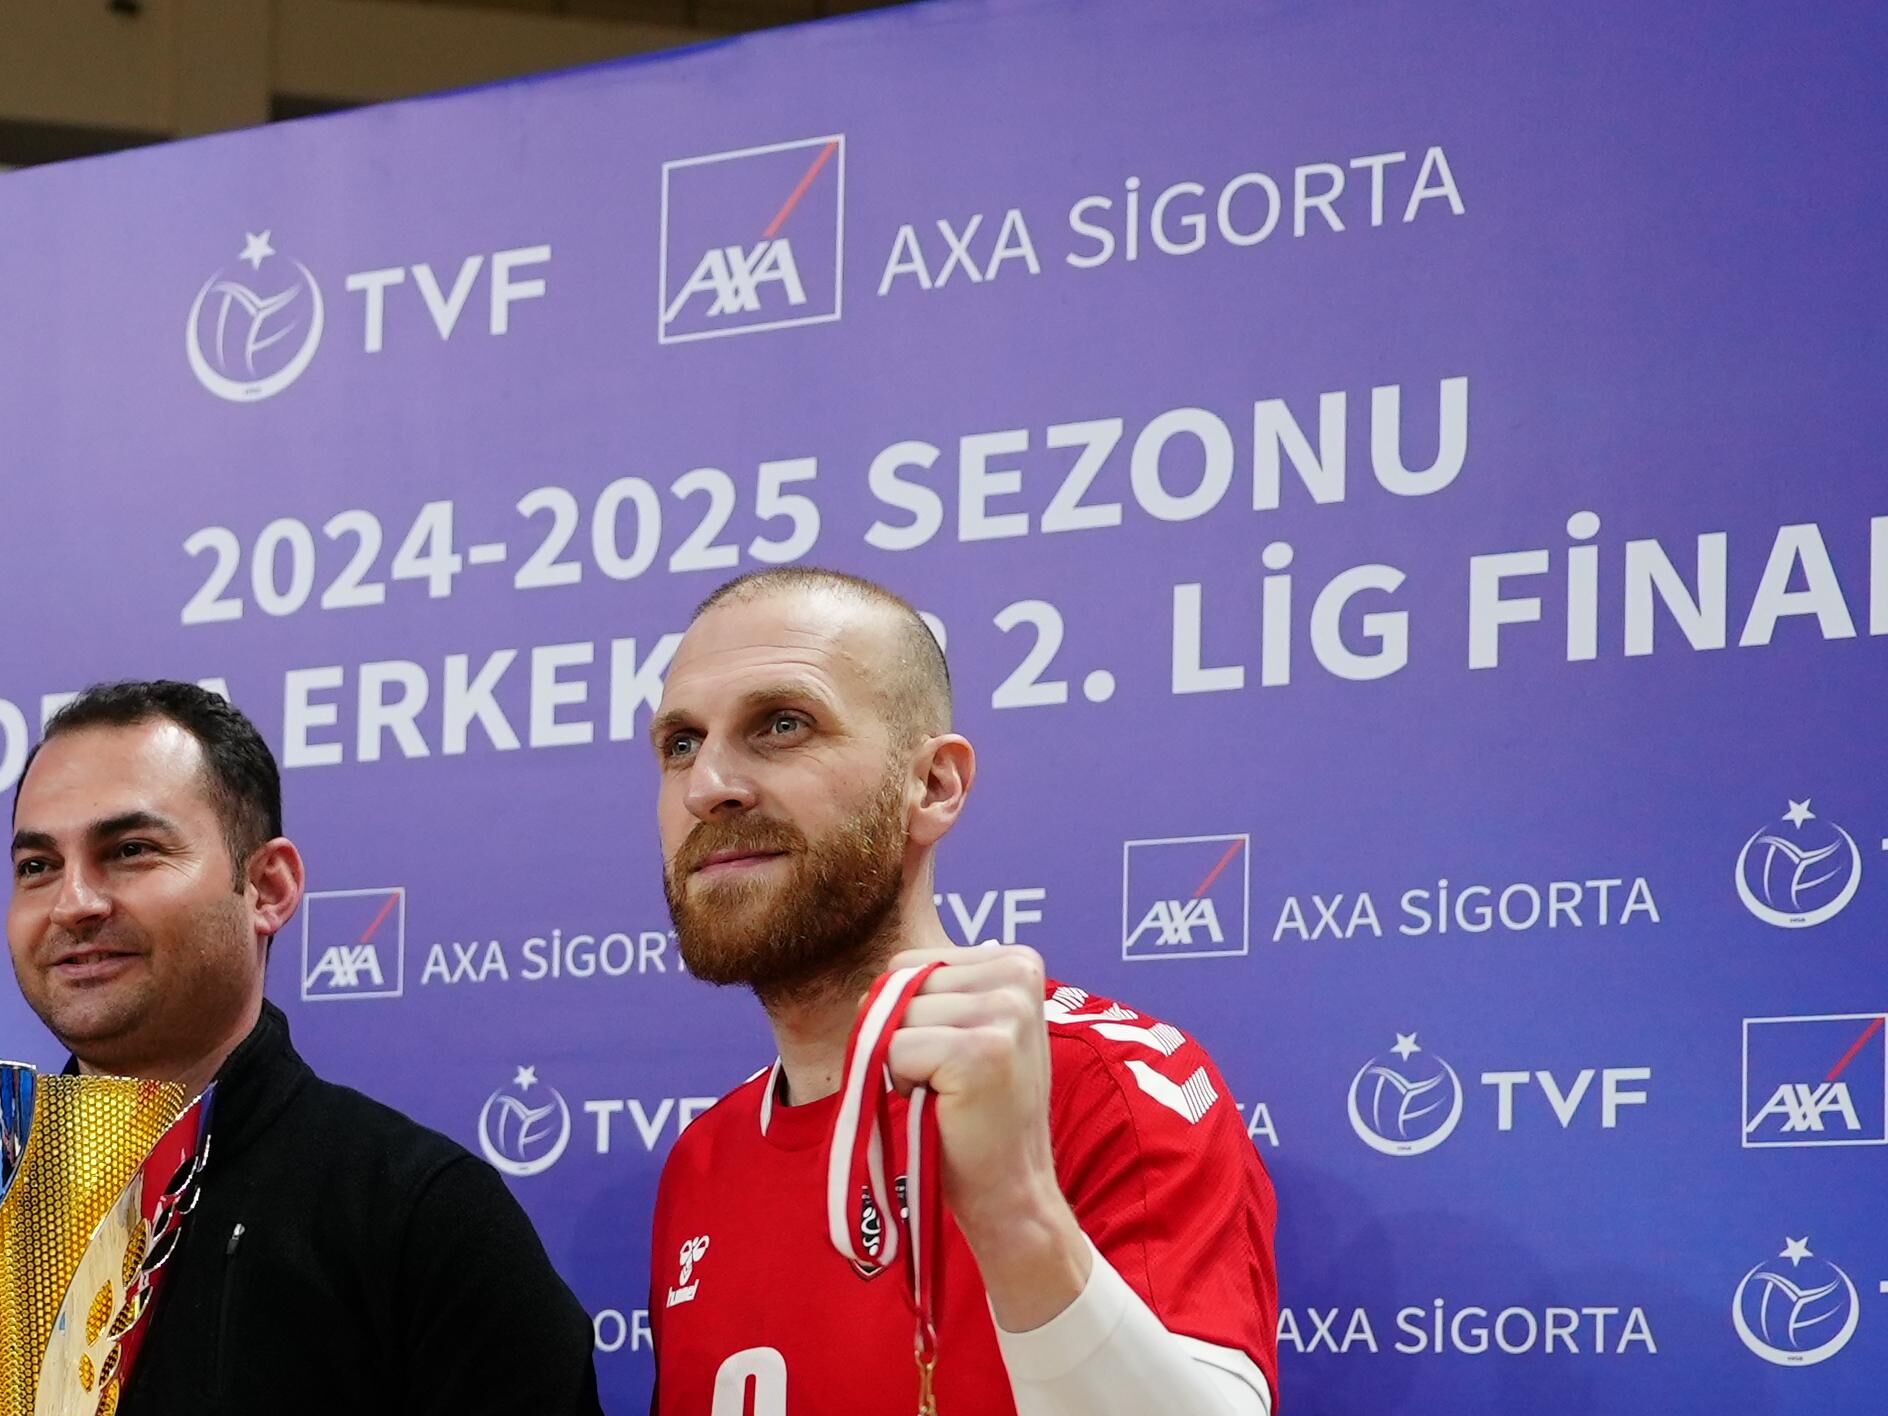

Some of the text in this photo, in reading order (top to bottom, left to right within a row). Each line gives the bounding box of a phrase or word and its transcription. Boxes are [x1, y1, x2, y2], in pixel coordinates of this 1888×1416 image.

[877, 146, 1465, 297] AXA SİGORTA
[345, 243, 553, 355] TVF
[664, 237, 807, 324] AXA
[180, 375, 1468, 627] 2024-2025 SEZONU
[991, 600, 1115, 710] 2.
[1170, 540, 1410, 696] LİG
[933, 887, 1047, 946] VF
[1125, 897, 1226, 947] AXA
[1272, 876, 1662, 943] AXA SİGORTA
[305, 944, 385, 989] AXA
[420, 928, 687, 985] AXA SİGOR
[1480, 1066, 1652, 1131] TVF
[1745, 1080, 1863, 1134] AXA
[1275, 1298, 1658, 1355] AXA SİGORTA
